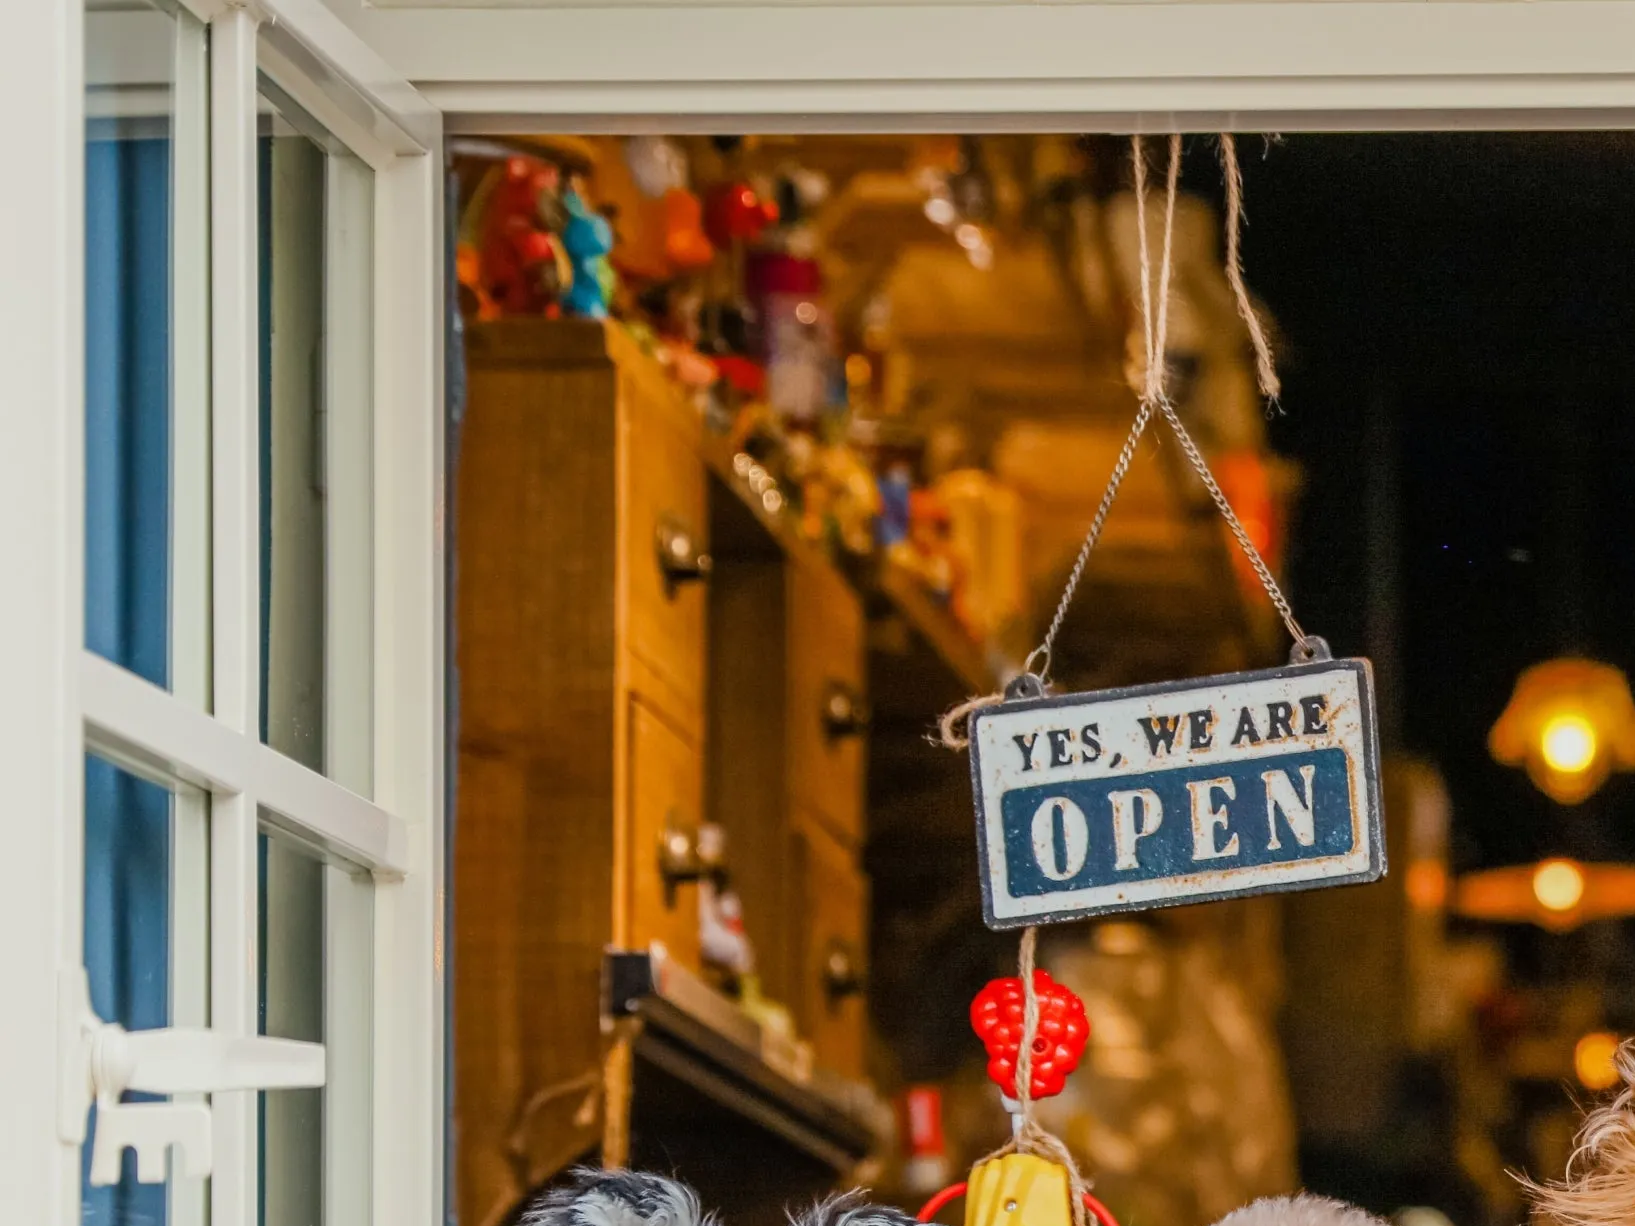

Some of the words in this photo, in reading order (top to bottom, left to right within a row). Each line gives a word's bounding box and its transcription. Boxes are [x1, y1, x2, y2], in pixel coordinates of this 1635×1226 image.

[1012, 722, 1123, 772] YES,
[1137, 706, 1214, 756] WE
[1230, 694, 1329, 746] ARE
[1030, 764, 1316, 882] OPEN
